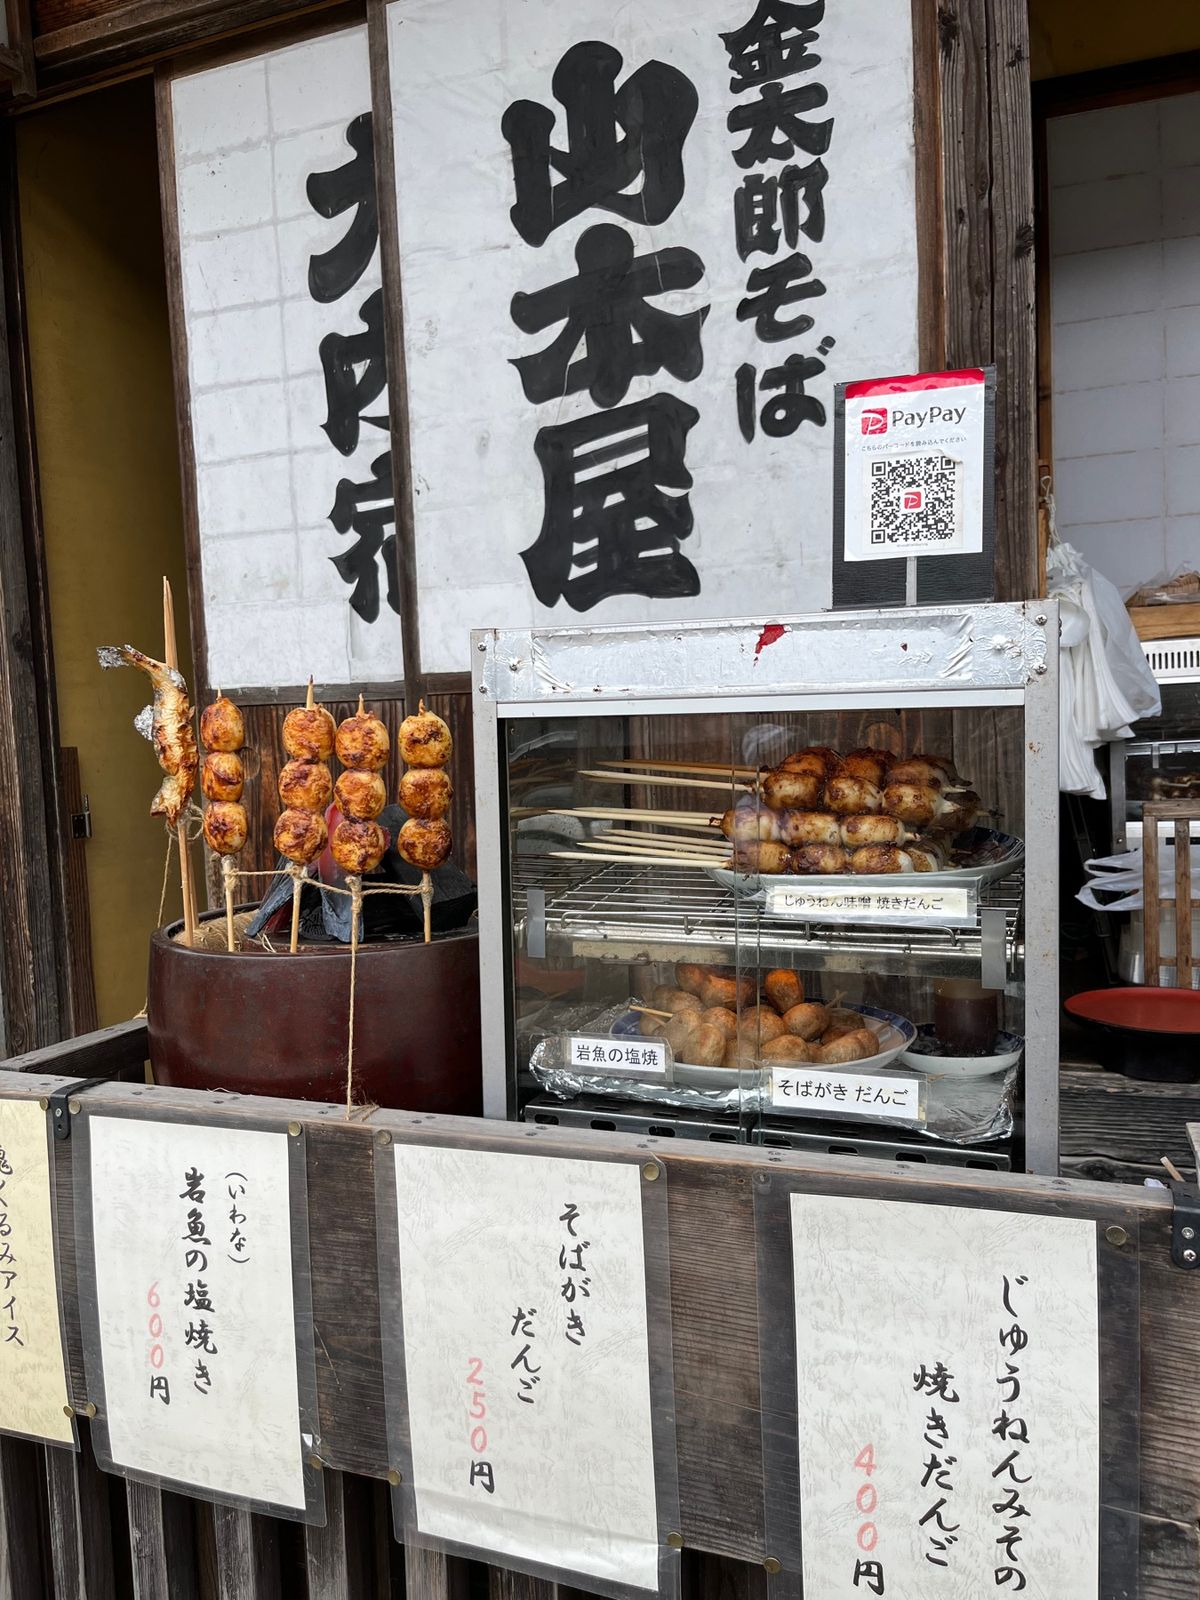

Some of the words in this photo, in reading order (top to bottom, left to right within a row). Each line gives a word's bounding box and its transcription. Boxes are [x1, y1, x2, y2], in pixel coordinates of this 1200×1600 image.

[501, 40, 711, 613] 山本屋
[892, 406, 967, 429] PayPay
[876, 896, 944, 910] 焼きだんご
[576, 1044, 659, 1066] 岩魚の塩焼
[778, 1079, 848, 1101] そばがき
[855, 1085, 909, 1106] だんご
[178, 1166, 218, 1395] 岩魚の塩焼き
[558, 1203, 592, 1346] そばがき
[147, 1281, 171, 1406] 600円
[510, 1306, 542, 1404] だんご
[465, 1357, 496, 1494] 250円
[912, 1361, 961, 1567] 焼きだんご
[991, 1274, 1033, 1592] じゅうねんみその
[852, 1443, 886, 1596] 400円
